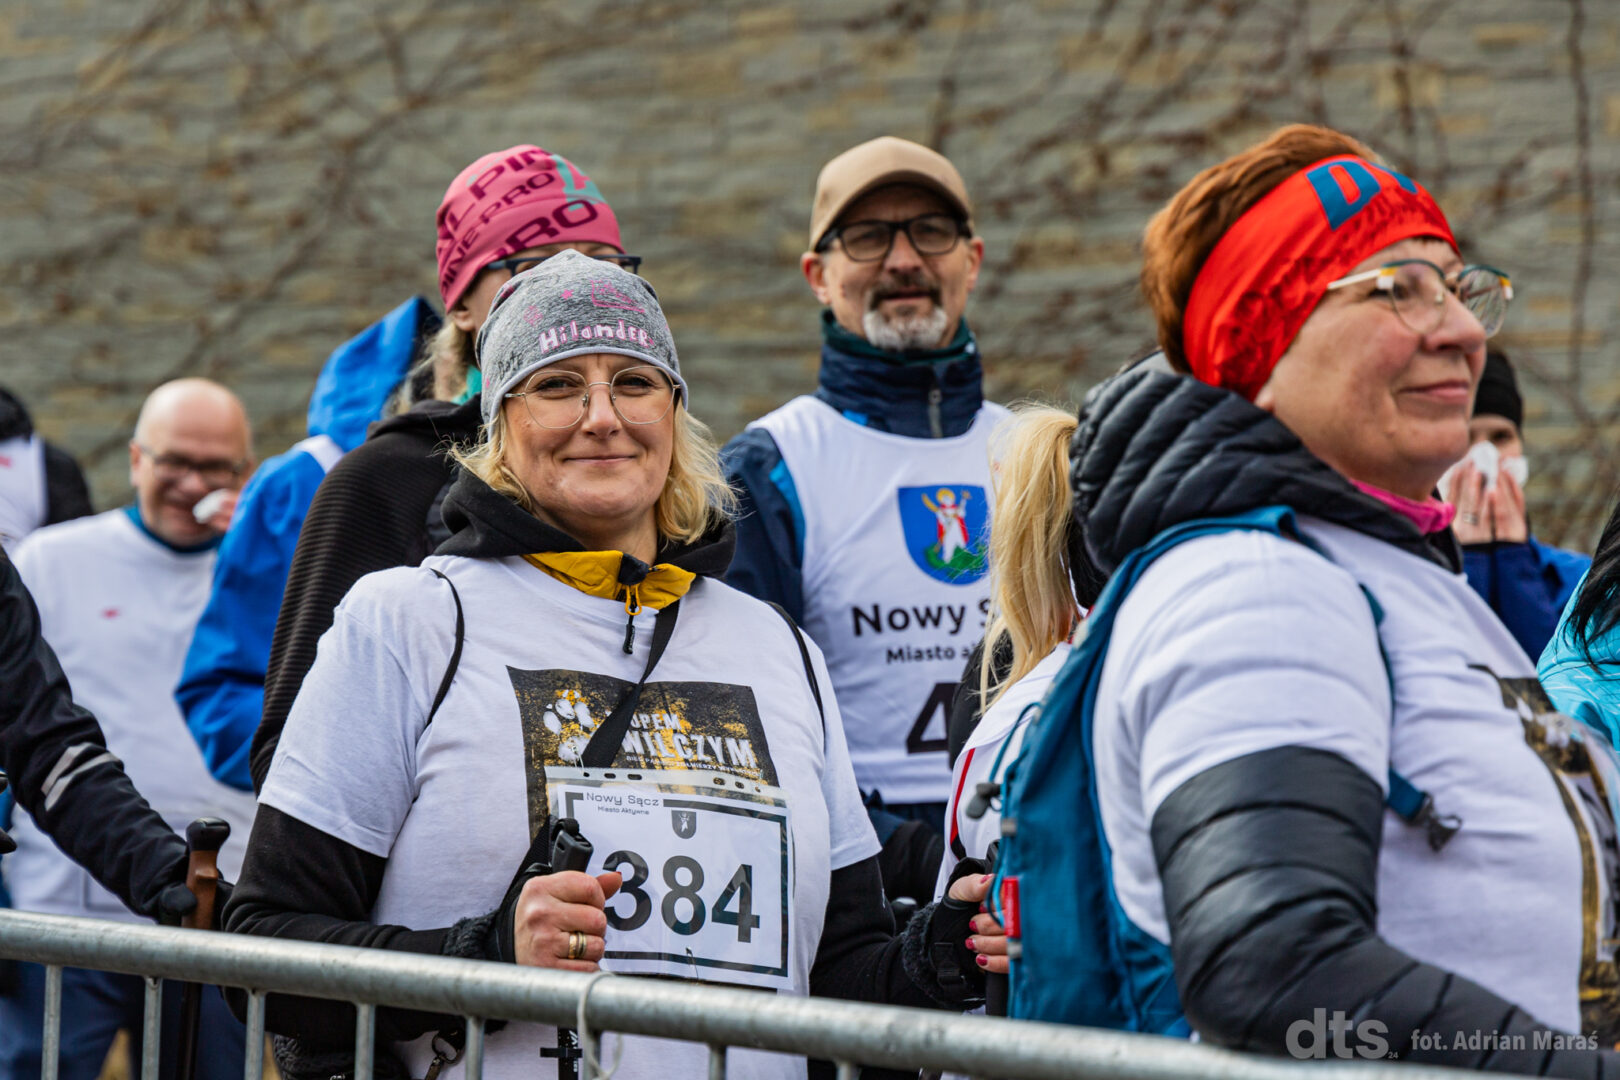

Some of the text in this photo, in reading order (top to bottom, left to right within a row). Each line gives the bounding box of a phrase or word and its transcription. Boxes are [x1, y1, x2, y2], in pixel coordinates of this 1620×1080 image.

[852, 603, 966, 637] Nowy
[887, 644, 956, 664] Miasto
[621, 729, 758, 769] WILCZYM
[586, 787, 660, 808] Nowy Sącz
[602, 850, 760, 943] 384
